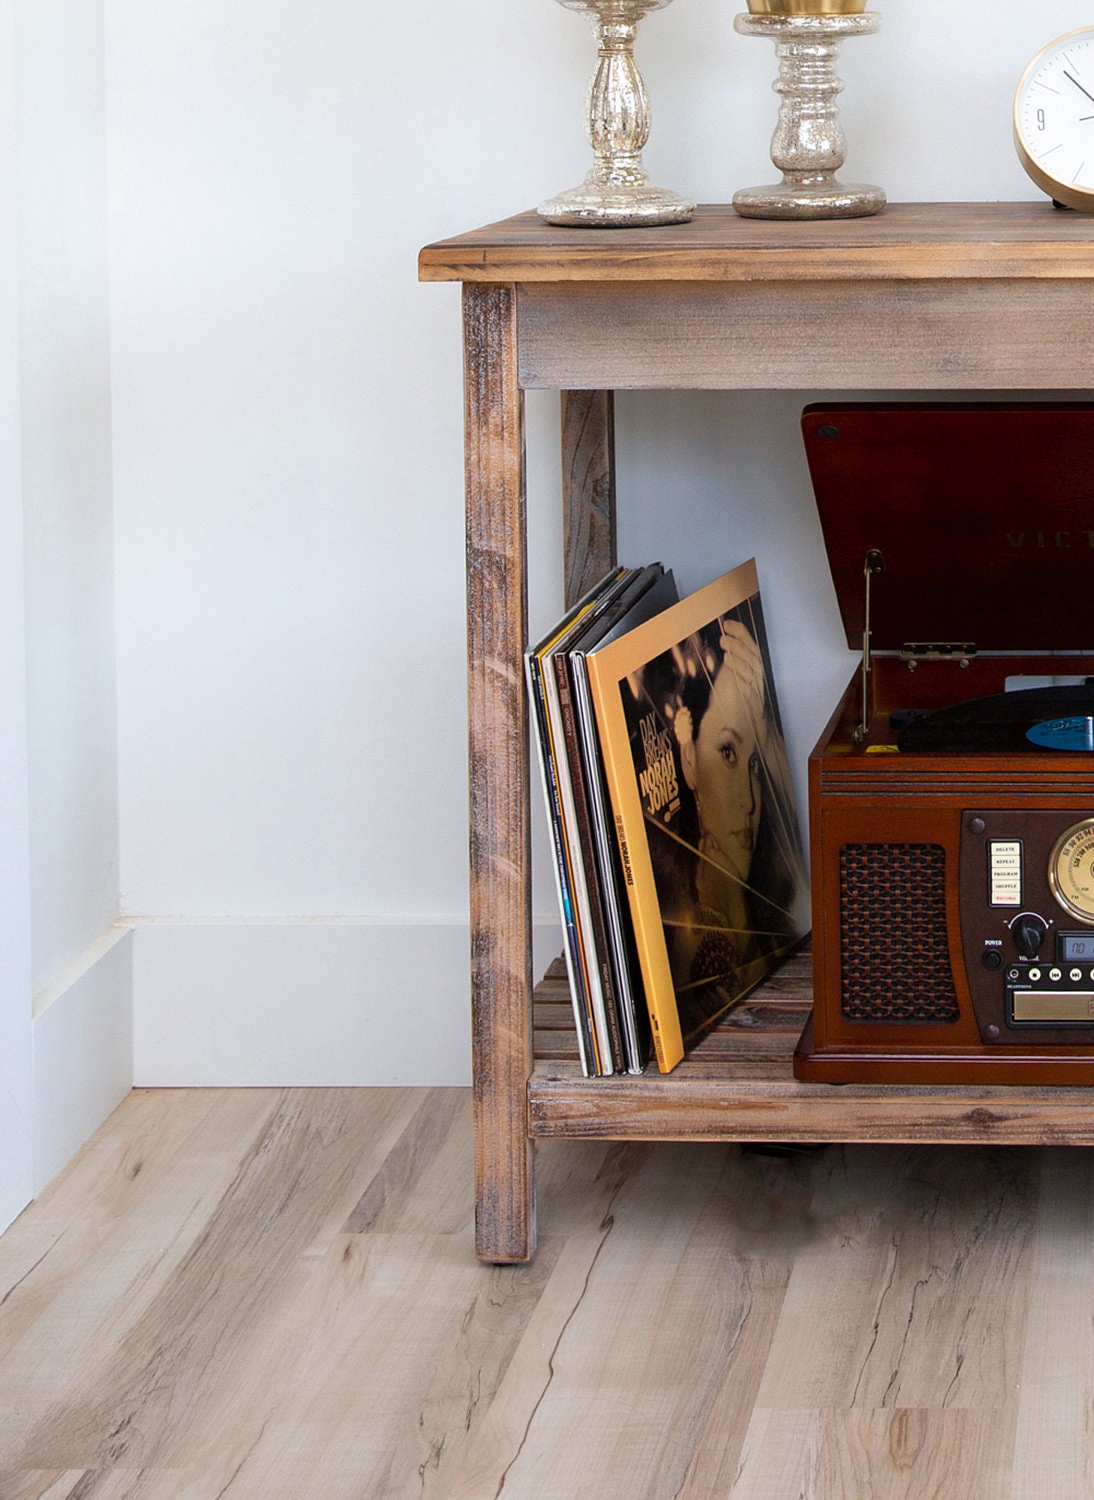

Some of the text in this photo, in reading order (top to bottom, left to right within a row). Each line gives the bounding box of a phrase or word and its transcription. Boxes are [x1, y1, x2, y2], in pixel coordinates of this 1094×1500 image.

[1037, 109, 1045, 130] 9
[639, 711, 657, 742] DAY
[639, 750, 677, 797] NORAH
[647, 780, 679, 815] JONES
[619, 841, 630, 864] NORAH
[624, 864, 633, 885] JONES
